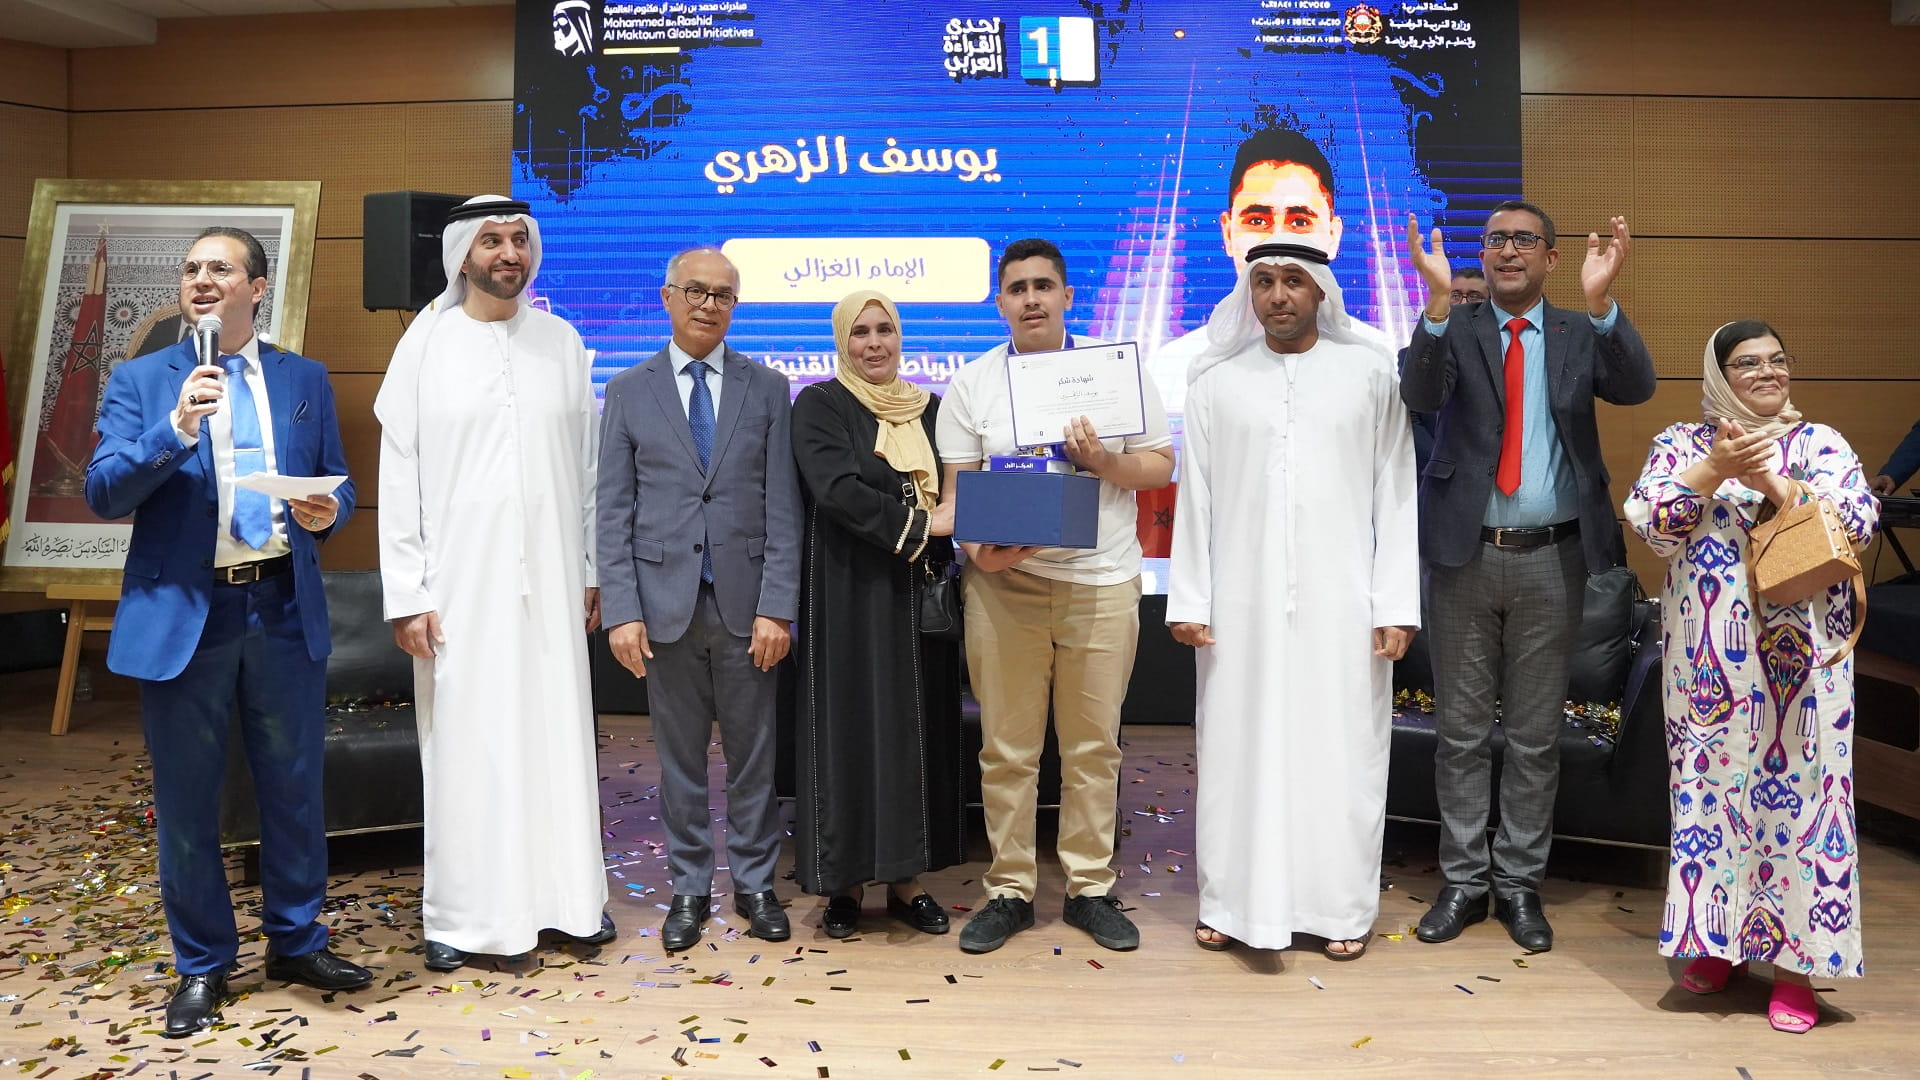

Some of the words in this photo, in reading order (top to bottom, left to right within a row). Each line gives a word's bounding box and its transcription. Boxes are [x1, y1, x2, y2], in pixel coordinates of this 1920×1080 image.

[603, 5, 633, 15] العالمية
[634, 3, 659, 15] مكتوم
[669, 3, 688, 14] راشد
[688, 3, 697, 13] بن
[698, 3, 718, 12] محمد
[1401, 2, 1429, 14] المغربية
[1429, 2, 1459, 11] المملكة
[603, 16, 664, 28] Mohammed
[677, 15, 713, 26] Rashid
[945, 17, 1001, 35] تحدي
[1389, 18, 1422, 30] الوطنية
[1423, 19, 1450, 32] التربية
[1451, 20, 1471, 31] وزارة
[603, 30, 615, 40] Al
[616, 29, 666, 40] Maktoum
[667, 27, 701, 39] Global
[703, 27, 754, 39] Initiatives
[942, 34, 1002, 57] القراءة
[944, 54, 1003, 77] العربي
[703, 134, 848, 194] الزهري
[858, 136, 1002, 183] يوسف
[783, 257, 860, 288] الغزالي
[867, 257, 926, 285] الإمام
[762, 354, 839, 381] القنيط
[897, 354, 966, 382] الرباط
